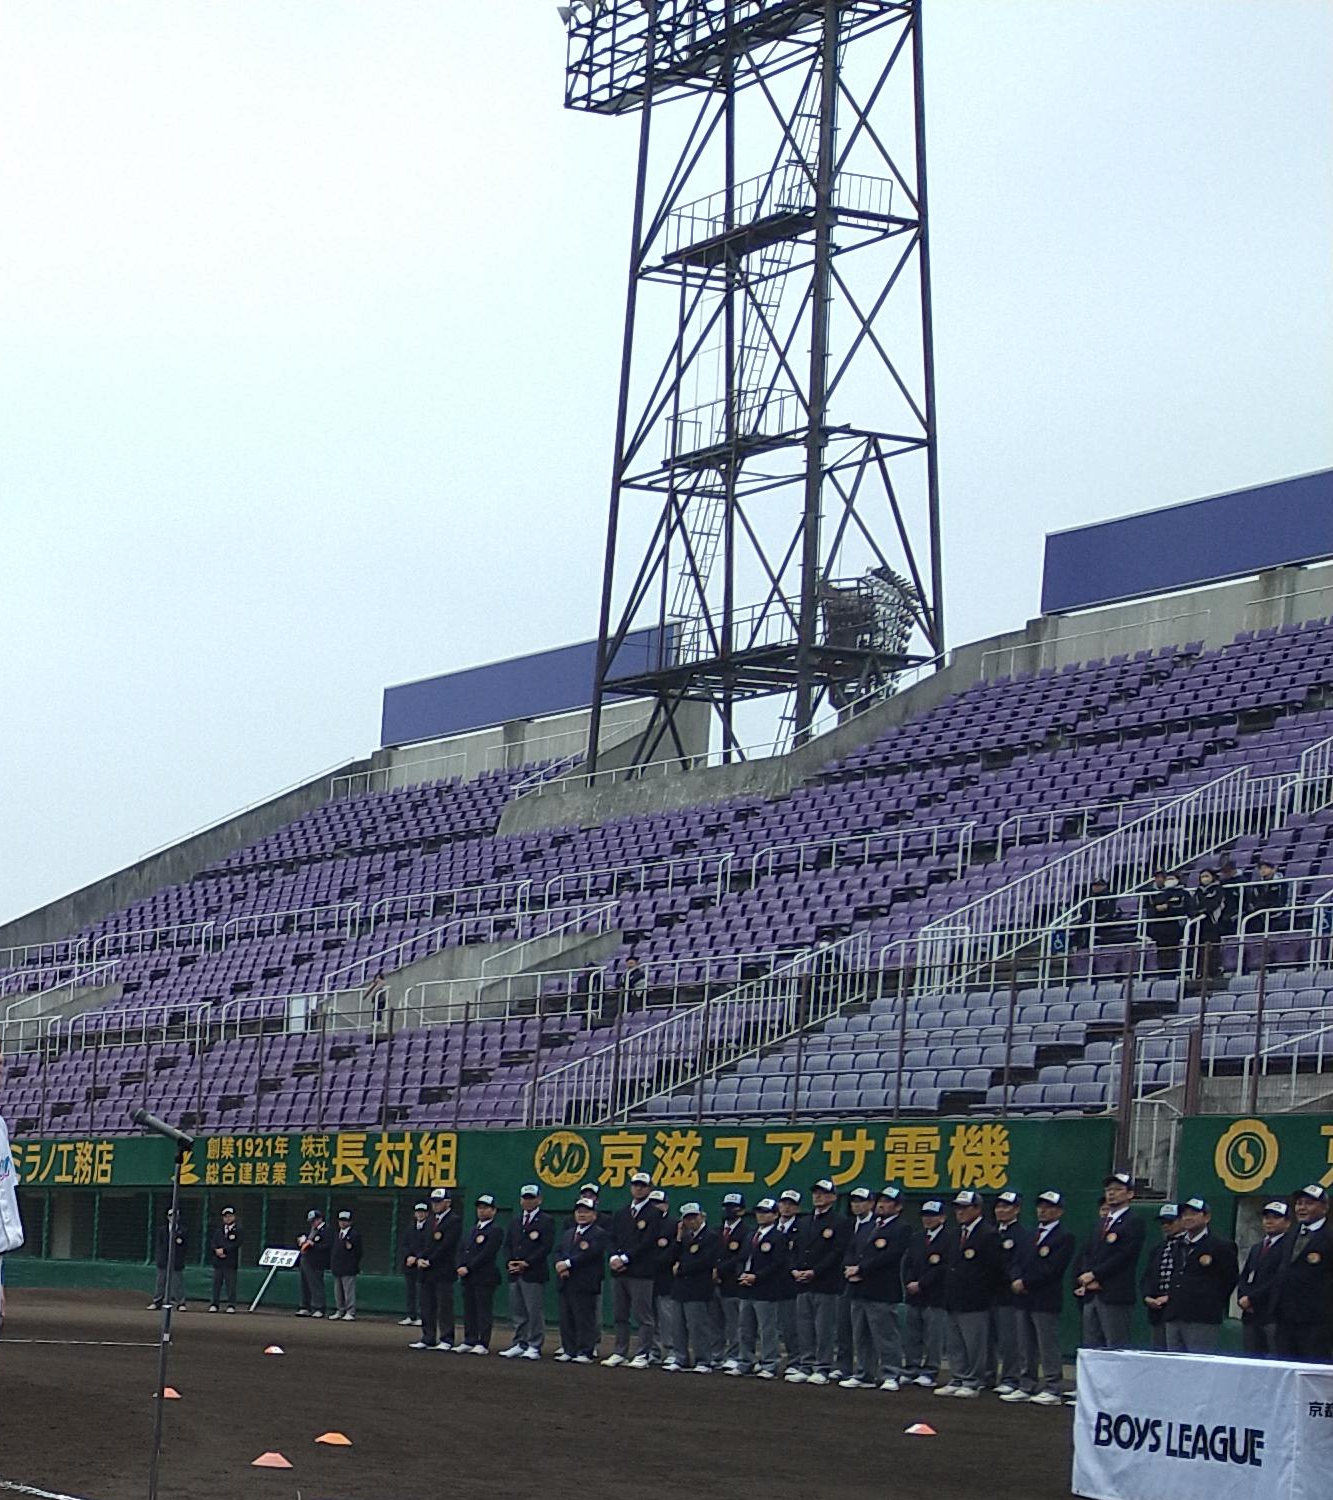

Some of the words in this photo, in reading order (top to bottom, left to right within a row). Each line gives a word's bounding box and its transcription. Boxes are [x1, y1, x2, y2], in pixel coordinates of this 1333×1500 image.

[206, 1136, 289, 1159] 創業1921年
[300, 1135, 330, 1158] 株式
[598, 1124, 1011, 1189] 京滋ユアサ電機
[330, 1132, 458, 1188] 長村組
[205, 1163, 288, 1185] 総合建設業
[299, 1163, 329, 1185] 会社
[1094, 1411, 1162, 1453] BOYS
[1166, 1421, 1265, 1468] LEAGUE
